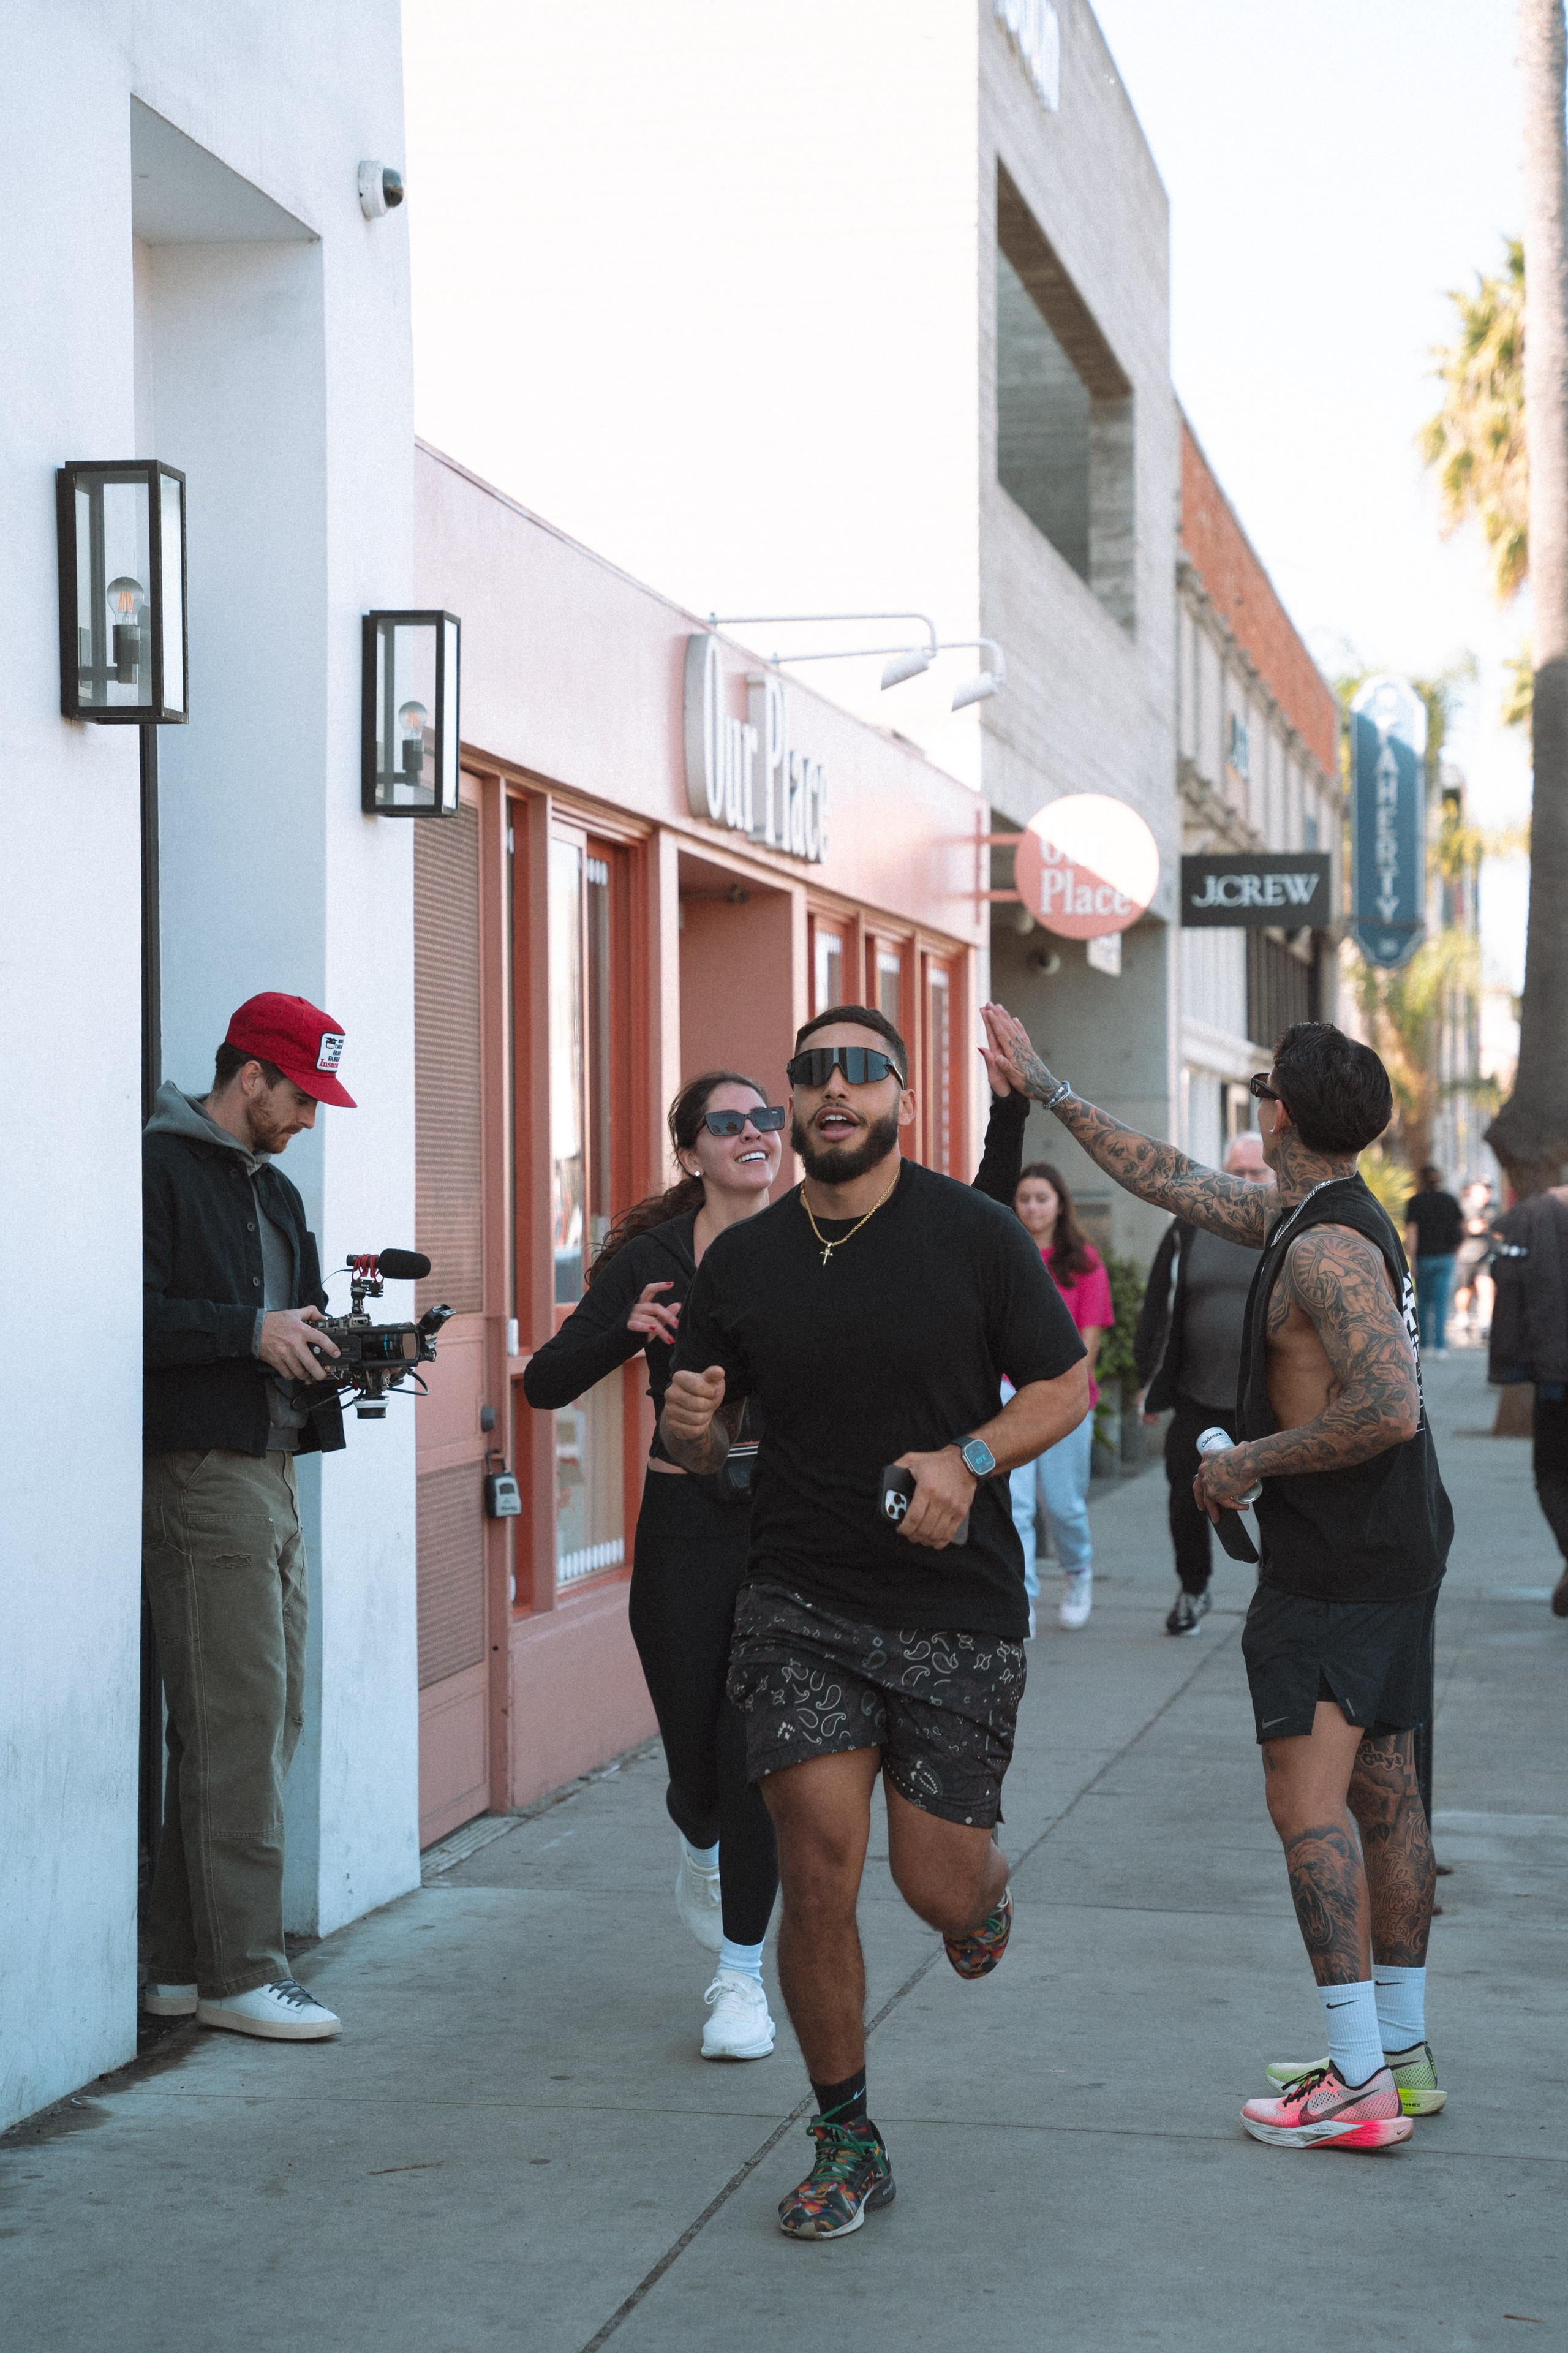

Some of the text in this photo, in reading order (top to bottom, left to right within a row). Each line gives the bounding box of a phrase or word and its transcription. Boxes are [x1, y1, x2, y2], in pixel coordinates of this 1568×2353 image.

[700, 634, 758, 834] Our
[1374, 712, 1400, 924] FAHERTY
[1039, 867, 1131, 916] Place
[1201, 1432, 1223, 1448] Cadence
